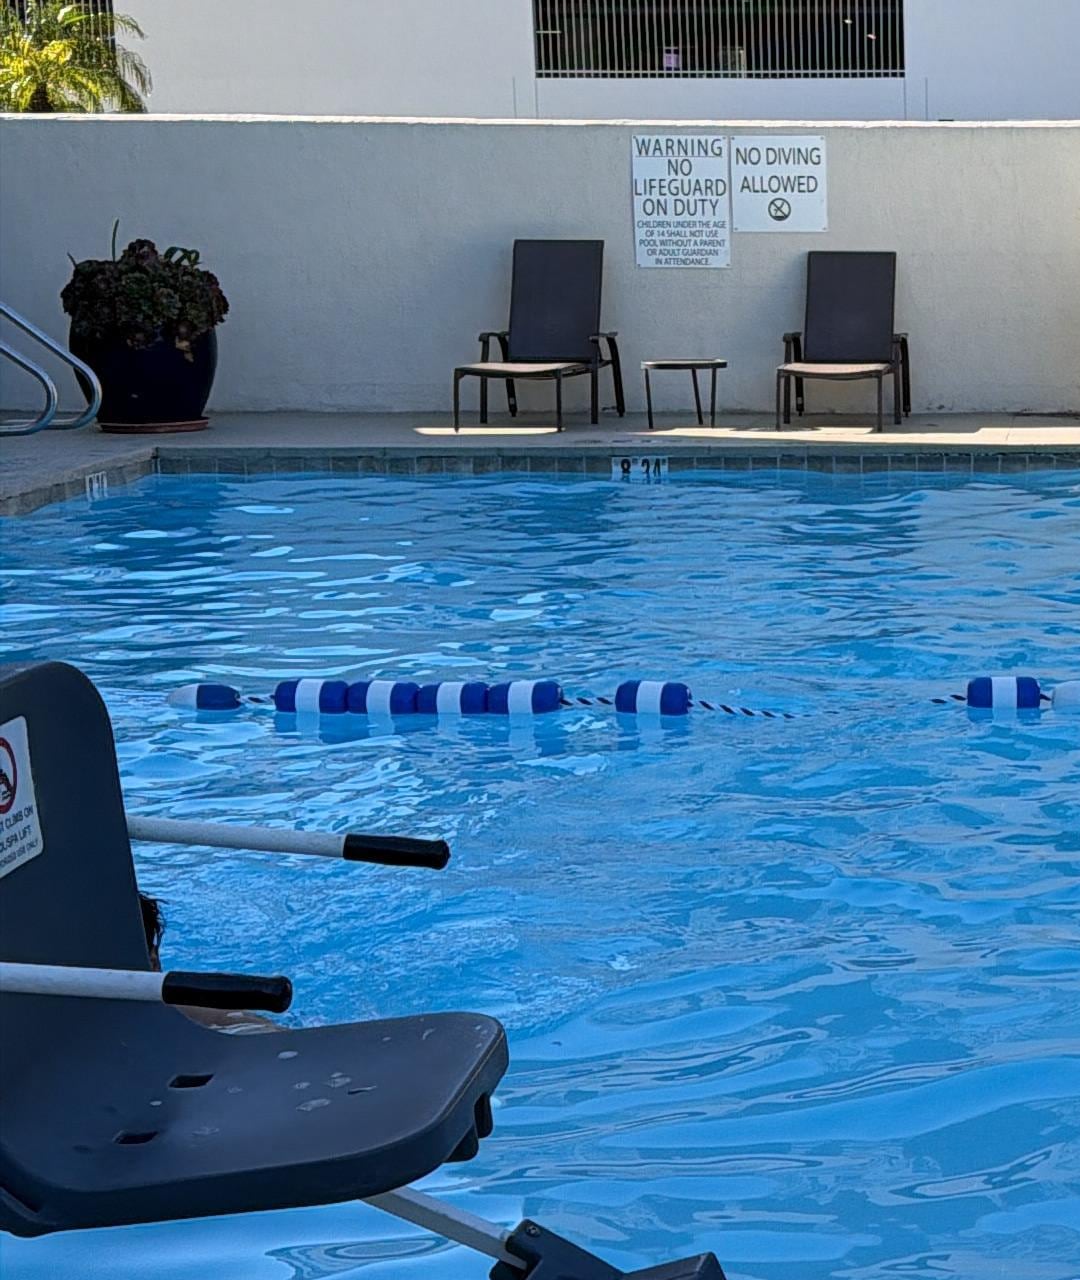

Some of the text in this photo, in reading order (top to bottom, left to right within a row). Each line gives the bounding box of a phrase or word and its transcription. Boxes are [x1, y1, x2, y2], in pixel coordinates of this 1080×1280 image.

[635, 138, 723, 156] WARNING
[735, 147, 821, 165] NO DIVING
[667, 158, 692, 176] NO
[634, 178, 727, 196] LIFEGUARD
[740, 175, 818, 193] ALLOWED
[642, 198, 720, 216] ON DUTY
[637, 220, 727, 228] CHILDREN UNDER THE AGE
[639, 239, 726, 247] POOL WITHOUT A PARENT
[645, 230, 719, 238] OF 14 SHALL NOT USE
[646, 248, 719, 257] OR ADULT GUARDIAN
[655, 258, 662, 266] IN
